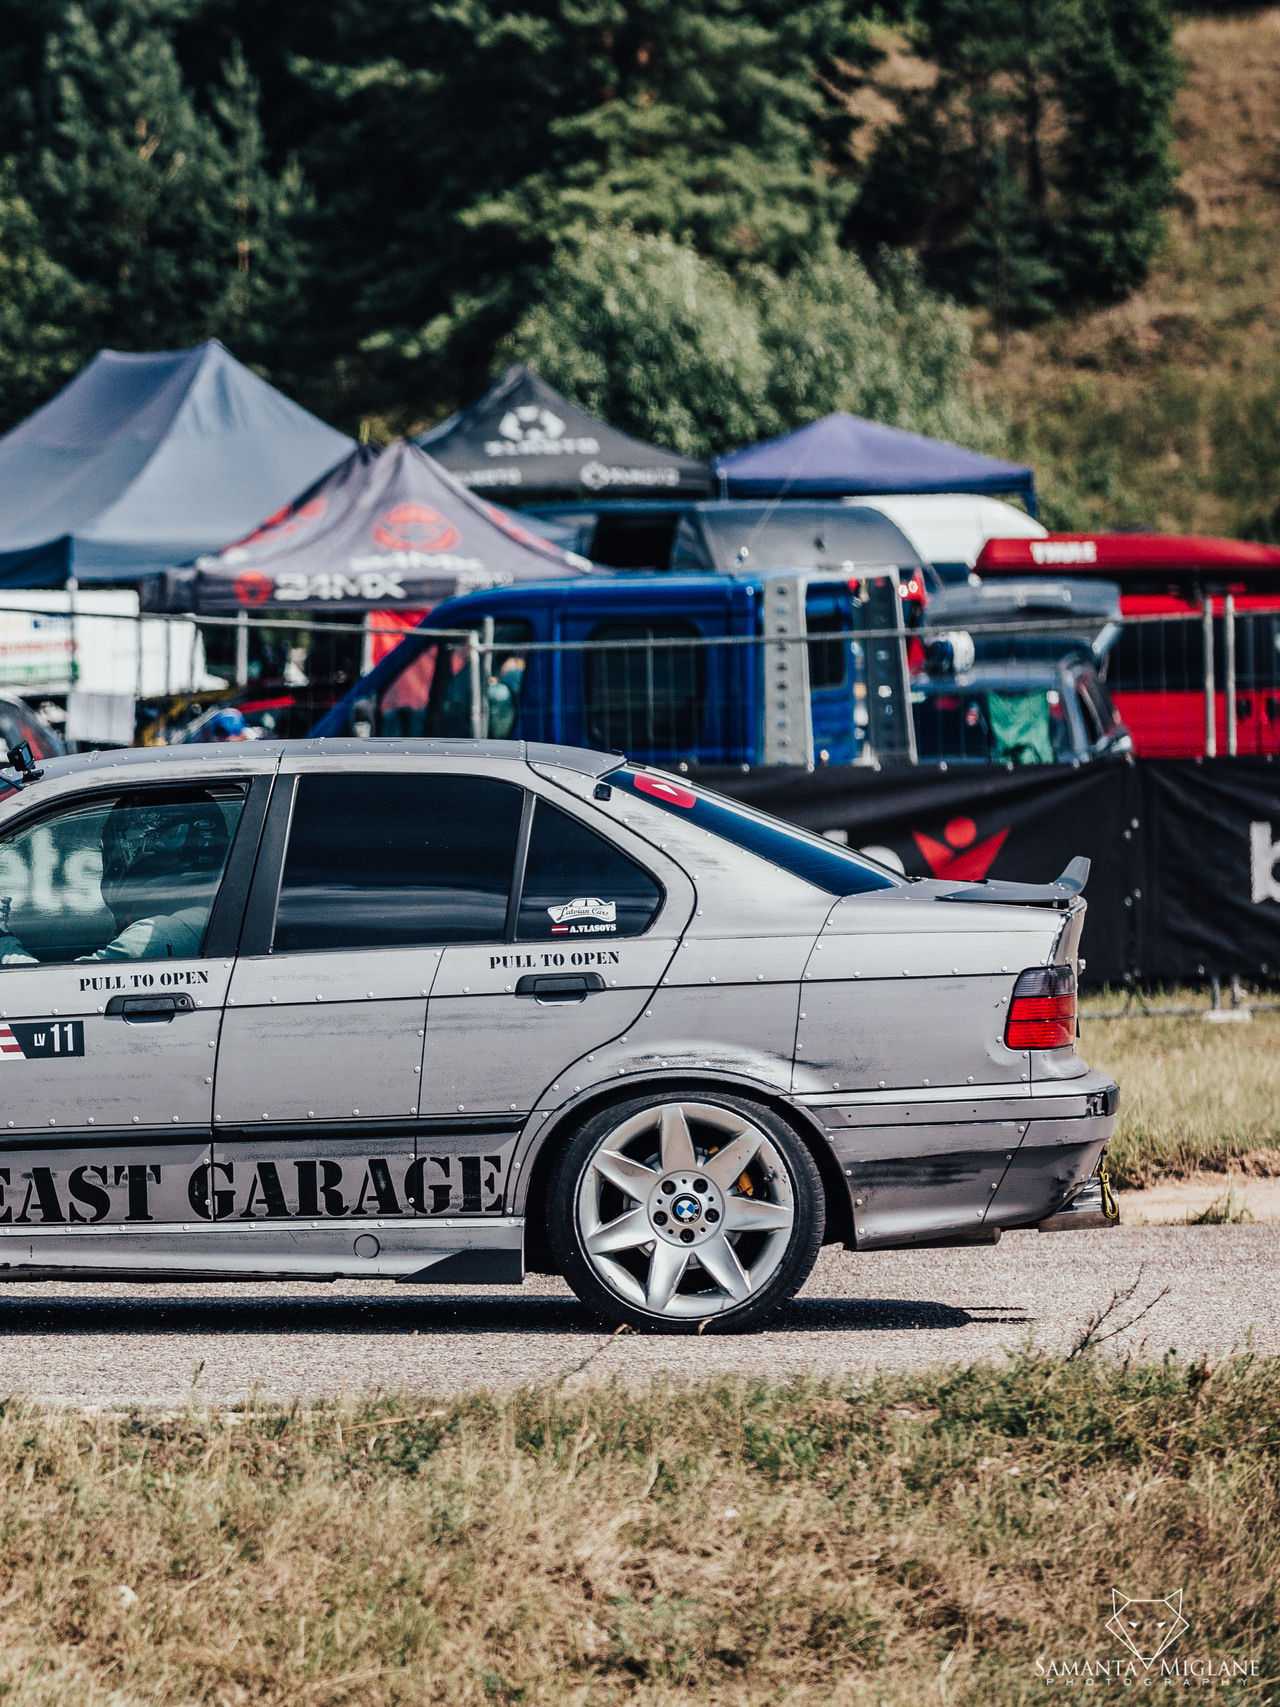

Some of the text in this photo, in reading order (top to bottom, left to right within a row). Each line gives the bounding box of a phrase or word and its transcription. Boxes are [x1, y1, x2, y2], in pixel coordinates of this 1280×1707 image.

[489, 951, 620, 970] PULL TO OPEN
[79, 970, 209, 992] PULL TO OPEN
[33, 1023, 75, 1052] LV 11
[187, 1155, 504, 1220] GARAGE
